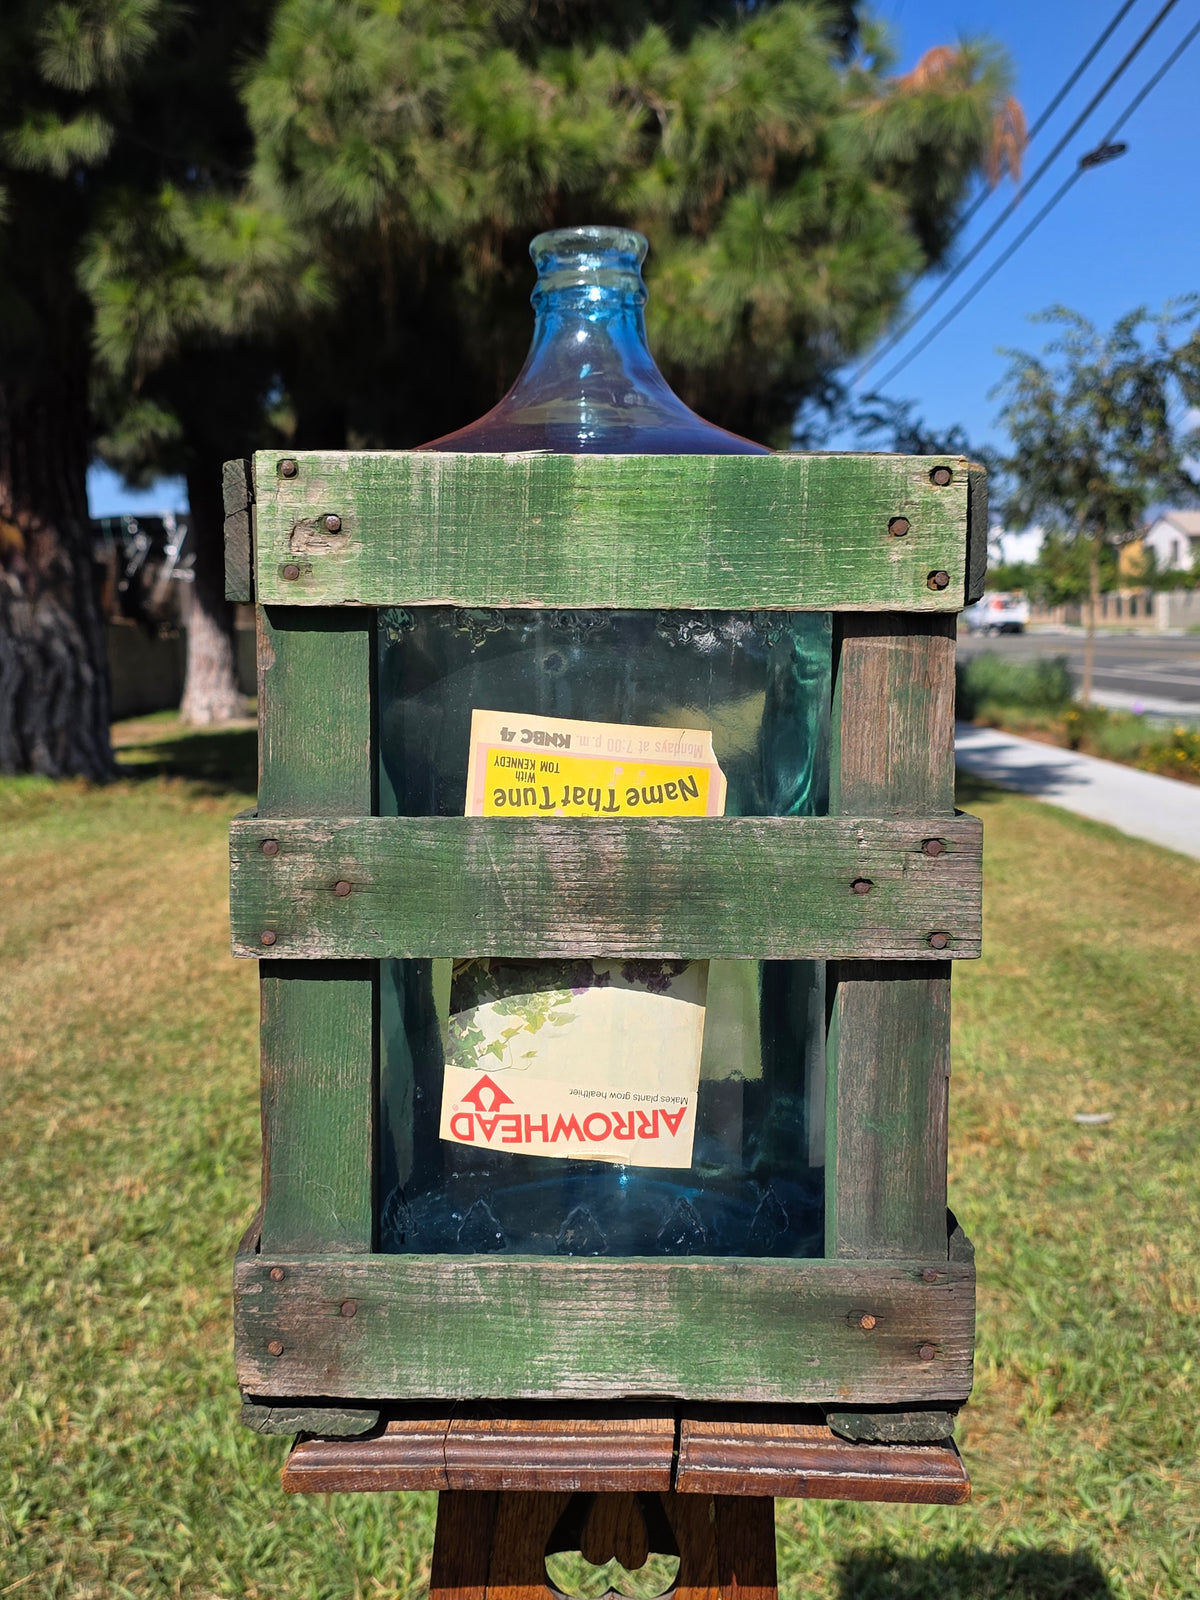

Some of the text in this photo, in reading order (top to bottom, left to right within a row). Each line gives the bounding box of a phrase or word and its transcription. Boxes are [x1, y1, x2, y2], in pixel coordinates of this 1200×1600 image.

[500, 727, 516, 743] 4
[521, 729, 571, 749] KNBC
[607, 739, 633, 752] 7:00
[639, 741, 649, 752] at
[655, 741, 703, 758] Mondays
[494, 755, 560, 773] TOM KENNEDY
[515, 771, 536, 783] With
[494, 775, 699, 812] Name That Tune
[610, 1092, 631, 1100] grow
[633, 1093, 659, 1103] plants
[661, 1096, 689, 1105] Makes
[450, 1106, 687, 1143] ARROWHEAD
